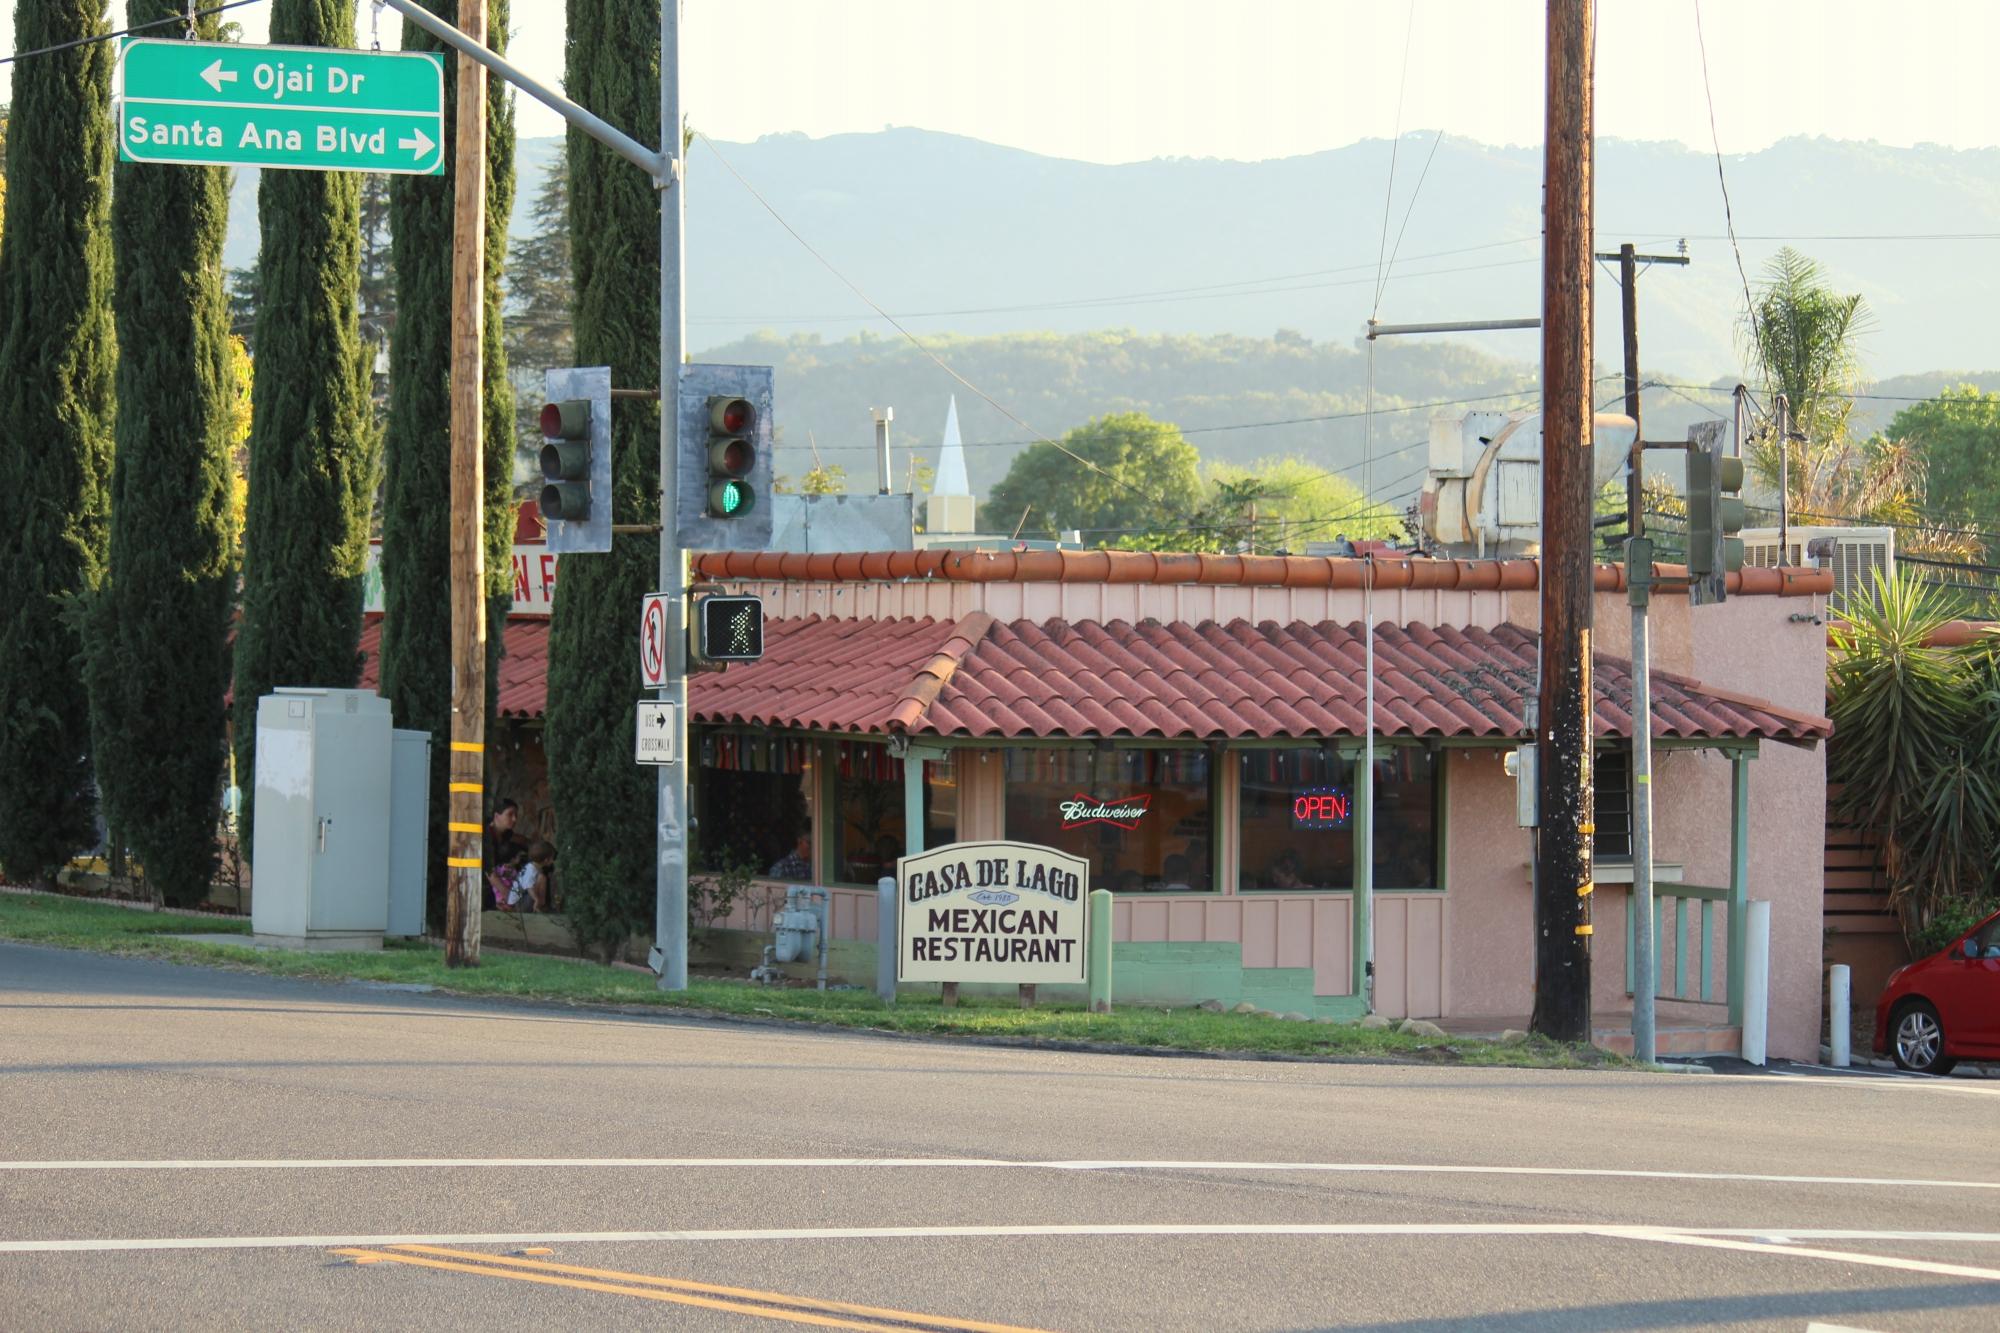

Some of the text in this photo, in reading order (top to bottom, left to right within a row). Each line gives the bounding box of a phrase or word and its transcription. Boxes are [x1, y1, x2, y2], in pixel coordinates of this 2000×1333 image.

[253, 63, 365, 99] Ojai Dr
[129, 116, 385, 154] Santa Ana Blvd
[645, 714, 655, 728] USE
[641, 738, 670, 752] CROSSWALK
[1060, 801, 1147, 821] Budweiser
[1295, 796, 1346, 820] OPEN
[909, 858, 1079, 903] CASA DE LAGO
[928, 908, 1059, 935] MEXICAN
[912, 937, 1077, 963] RESTAURANT
